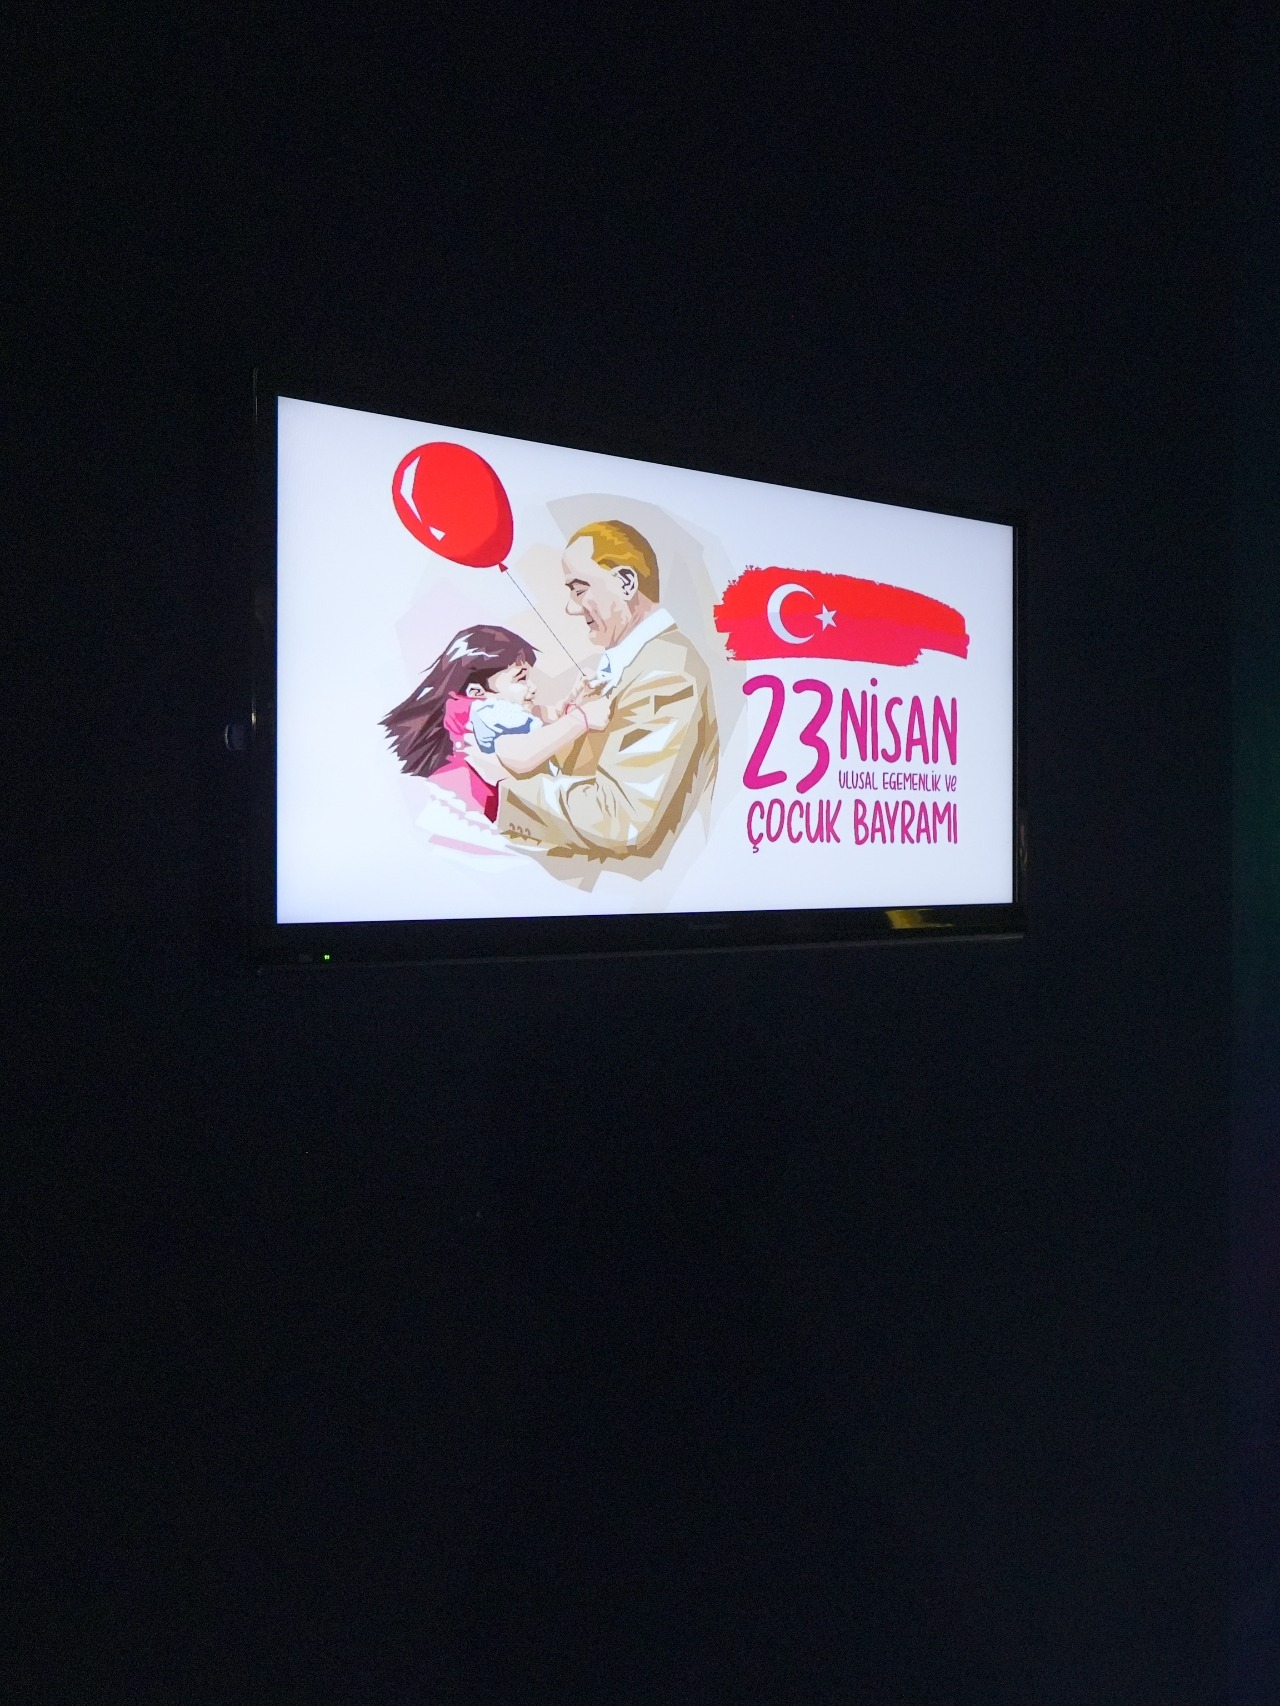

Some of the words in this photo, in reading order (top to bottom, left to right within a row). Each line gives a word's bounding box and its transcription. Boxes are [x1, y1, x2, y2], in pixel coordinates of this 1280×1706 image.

[742, 674, 834, 794] 23
[840, 677, 957, 765] NİSAN
[838, 769, 878, 790] ULUSAL
[882, 770, 942, 792] EGEMENLİK
[747, 798, 842, 854] ÇOCUK
[854, 799, 958, 845] BAYRAMI
